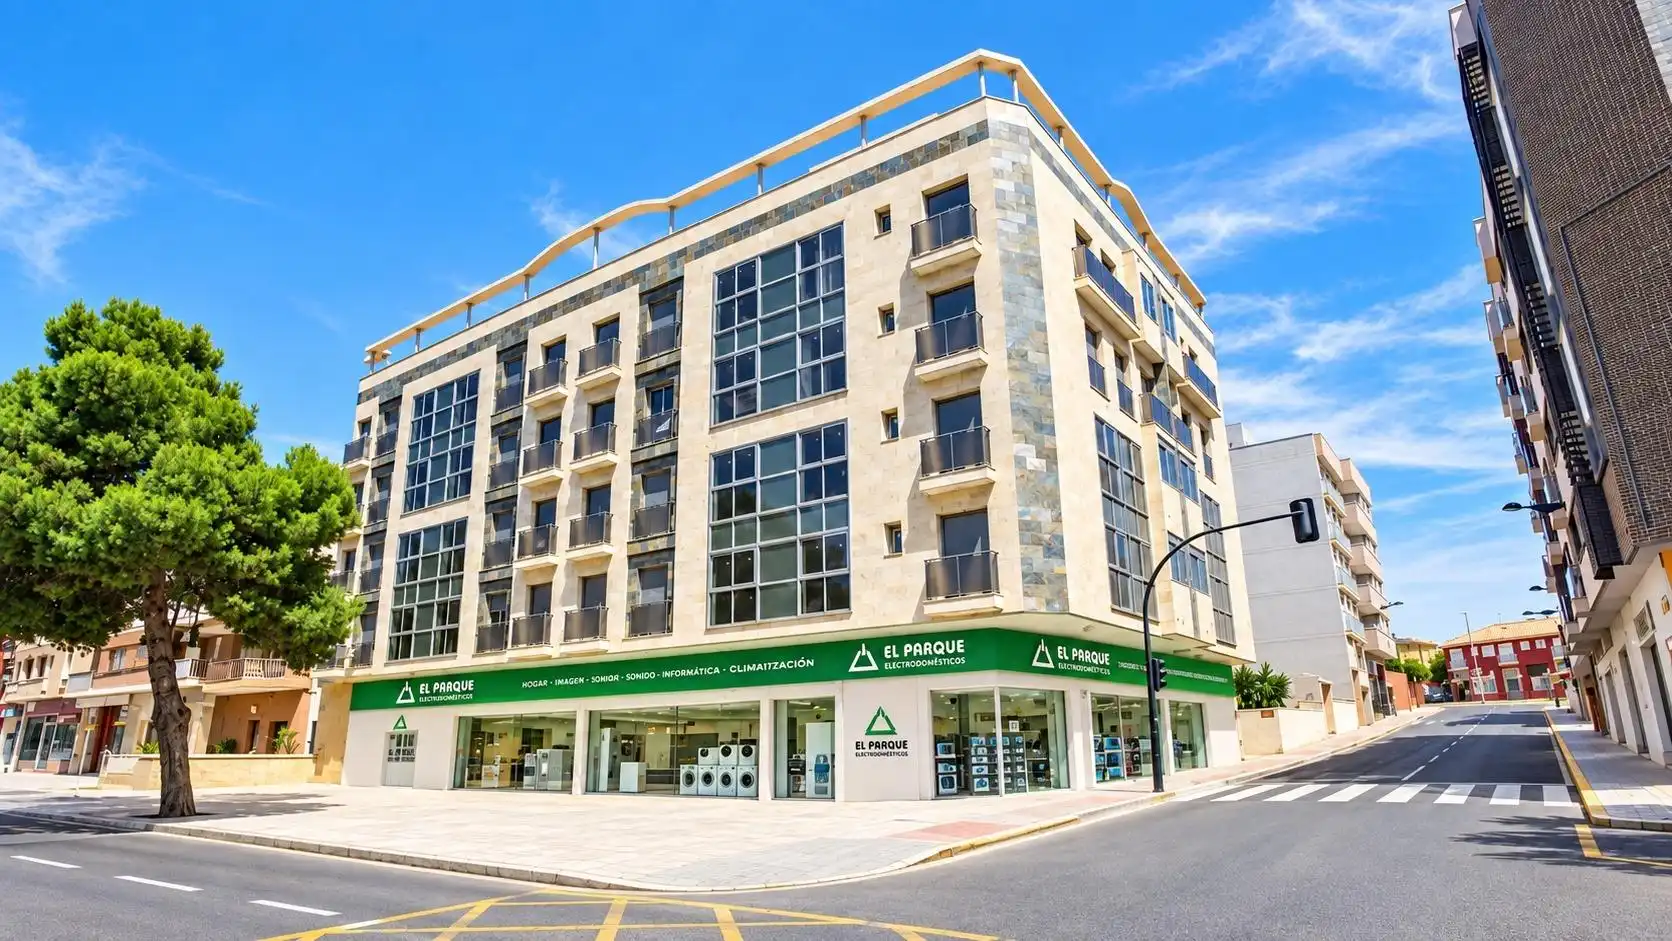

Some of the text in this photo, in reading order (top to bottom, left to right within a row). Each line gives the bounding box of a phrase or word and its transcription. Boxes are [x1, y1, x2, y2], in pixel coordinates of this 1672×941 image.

[884, 640, 965, 658] EL PARQUE
[1057, 646, 1110, 665] EL PARQUE
[662, 667, 720, 678] INFORMÁTICA
[419, 680, 474, 694] EL PARQUE
[855, 740, 908, 750] EL PARQUE
